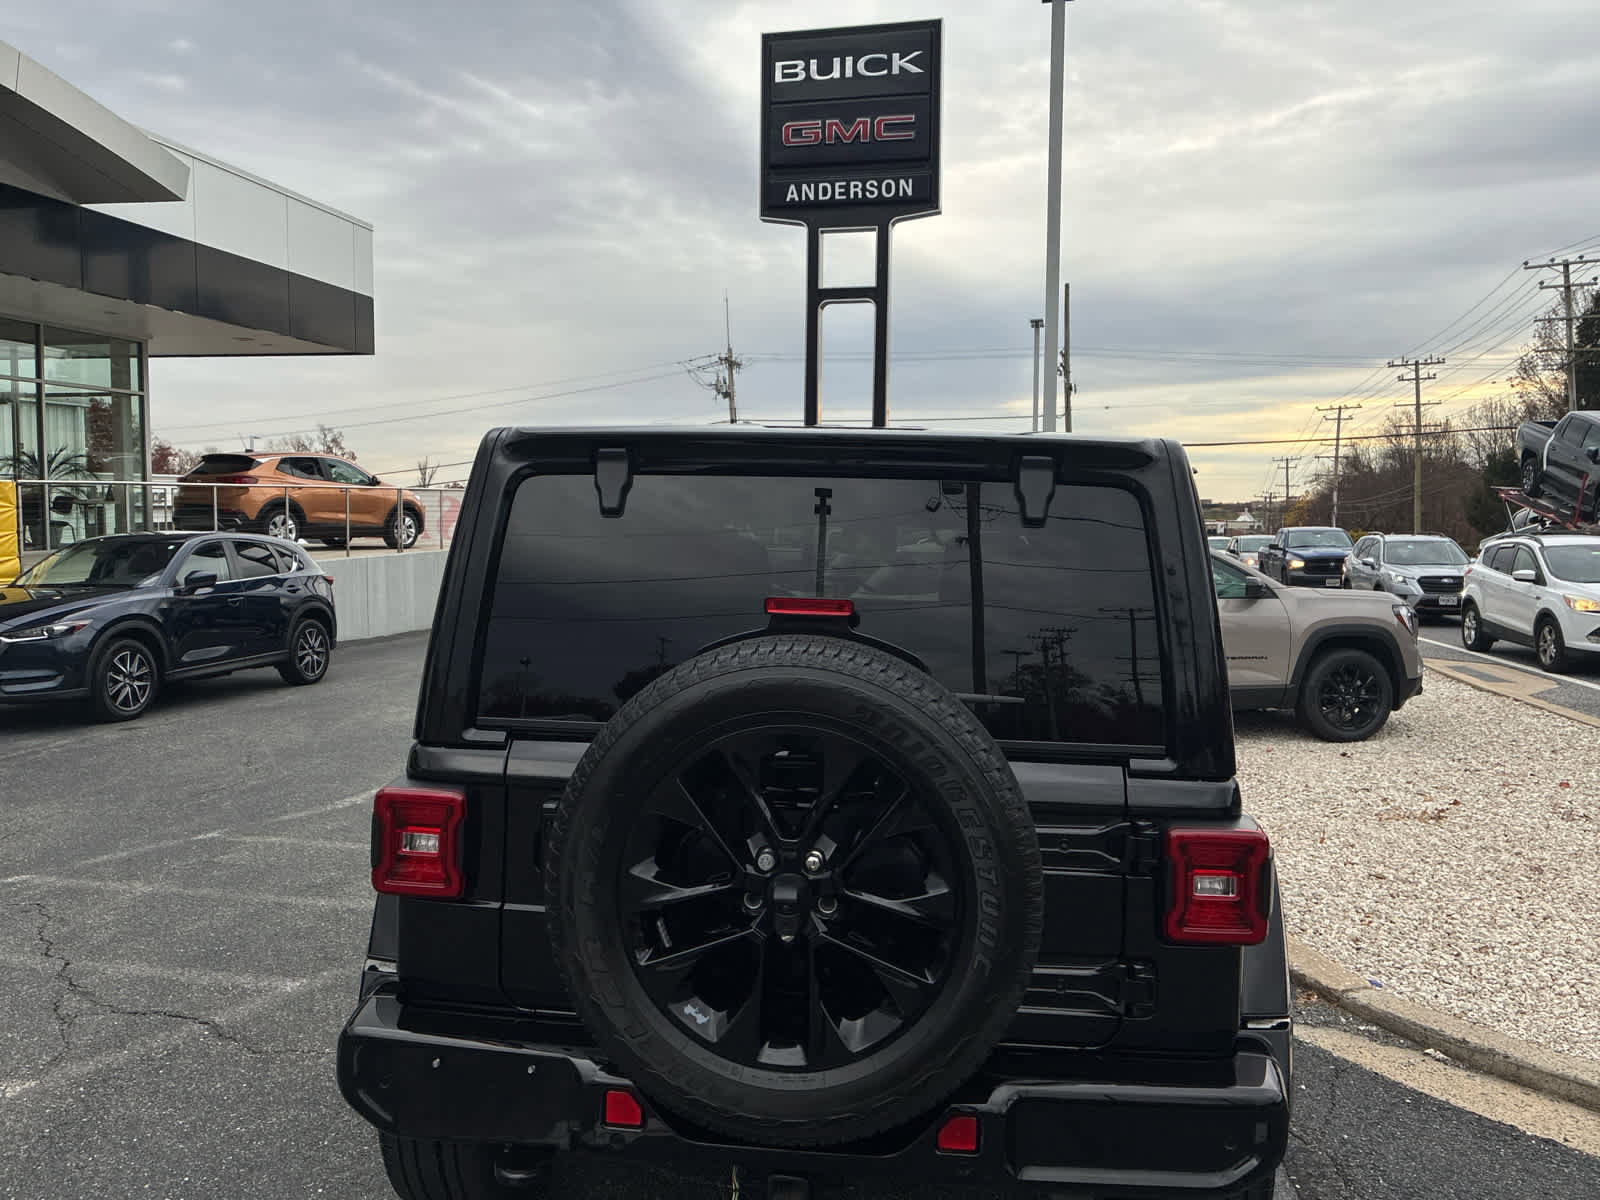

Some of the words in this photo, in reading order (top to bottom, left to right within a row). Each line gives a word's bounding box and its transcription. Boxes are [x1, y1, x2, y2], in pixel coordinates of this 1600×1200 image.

[774, 50, 925, 83] BUICK
[782, 114, 915, 147] GMC
[786, 178, 913, 202] ANDERSON
[860, 705, 1000, 978] DGESTONE
